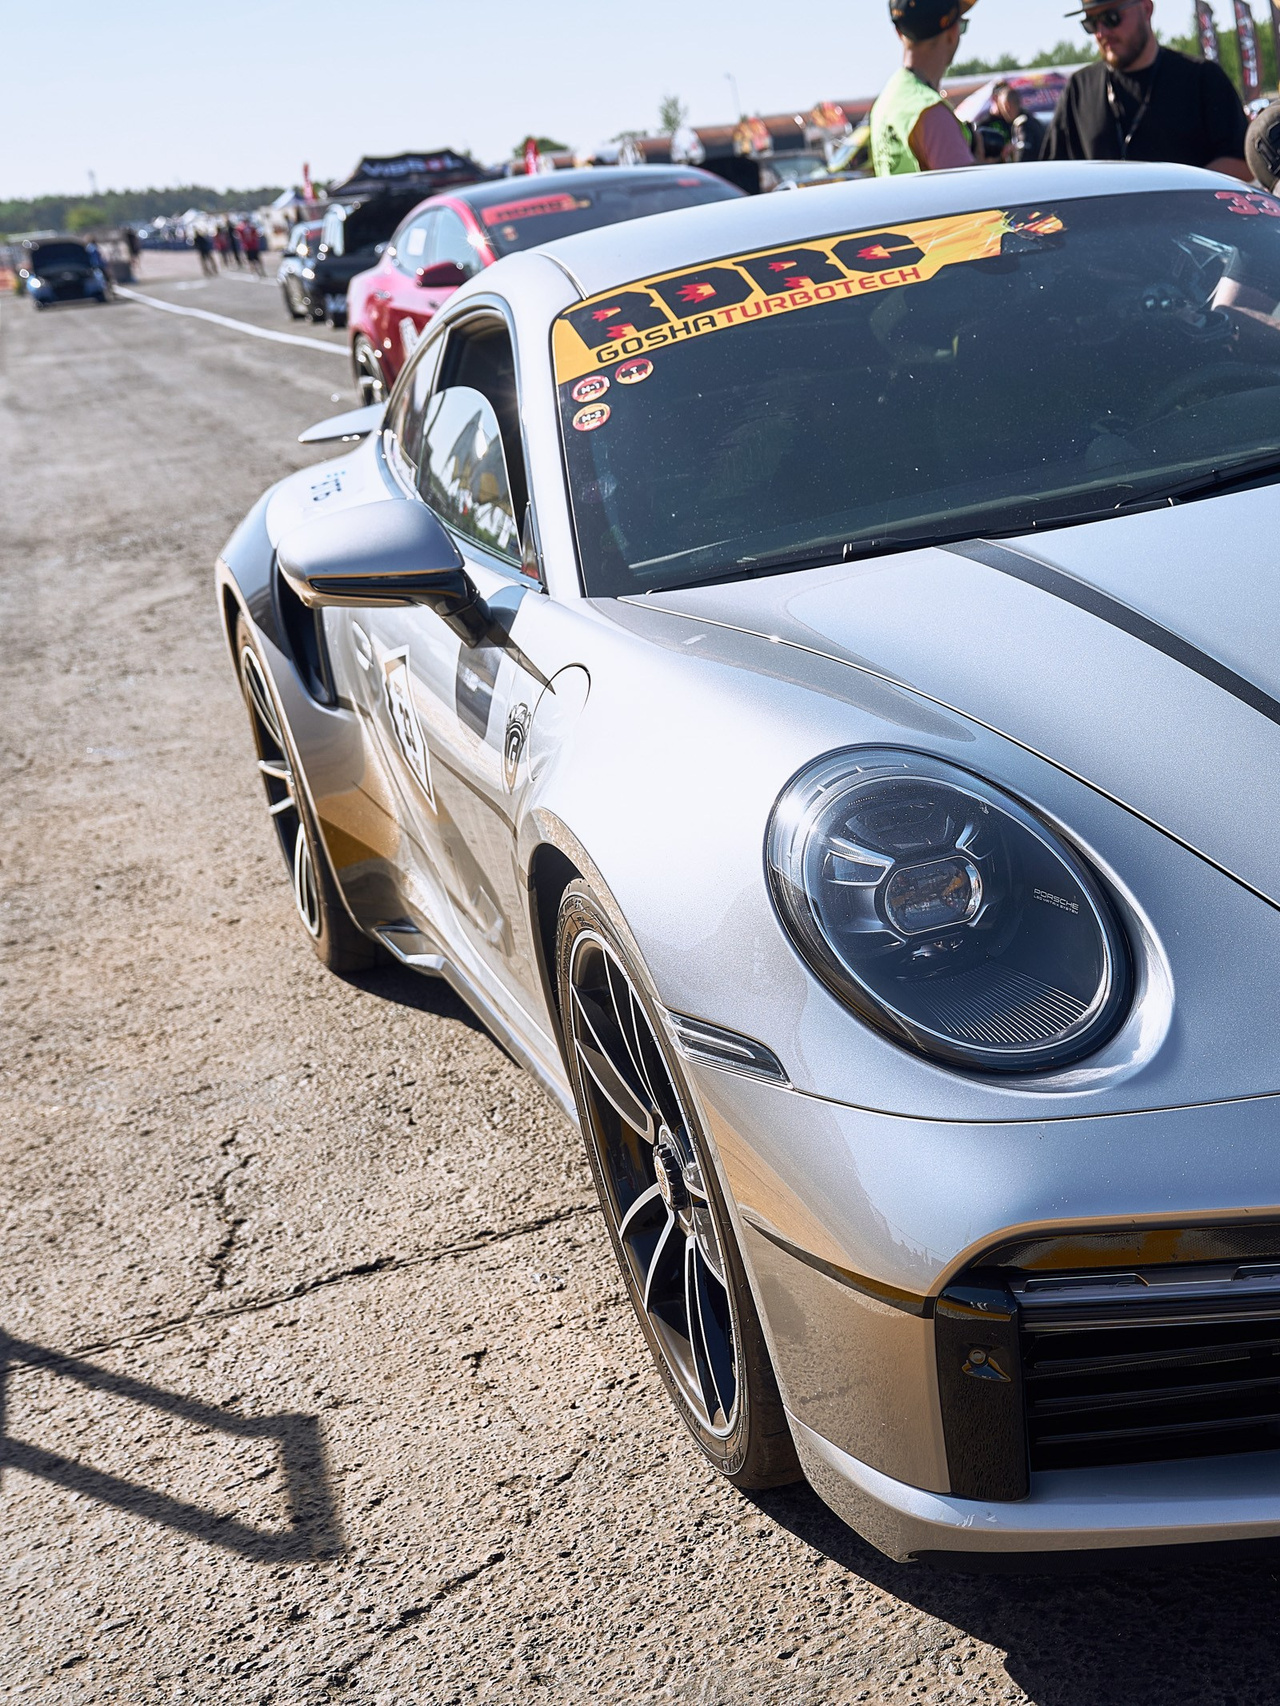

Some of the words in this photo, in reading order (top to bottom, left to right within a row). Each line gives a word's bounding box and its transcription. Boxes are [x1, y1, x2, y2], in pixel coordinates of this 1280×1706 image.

[557, 232, 926, 350] RDRC
[596, 266, 922, 364] GOSHATURBOTECH
[1033, 888, 1080, 911] PORSCHE
